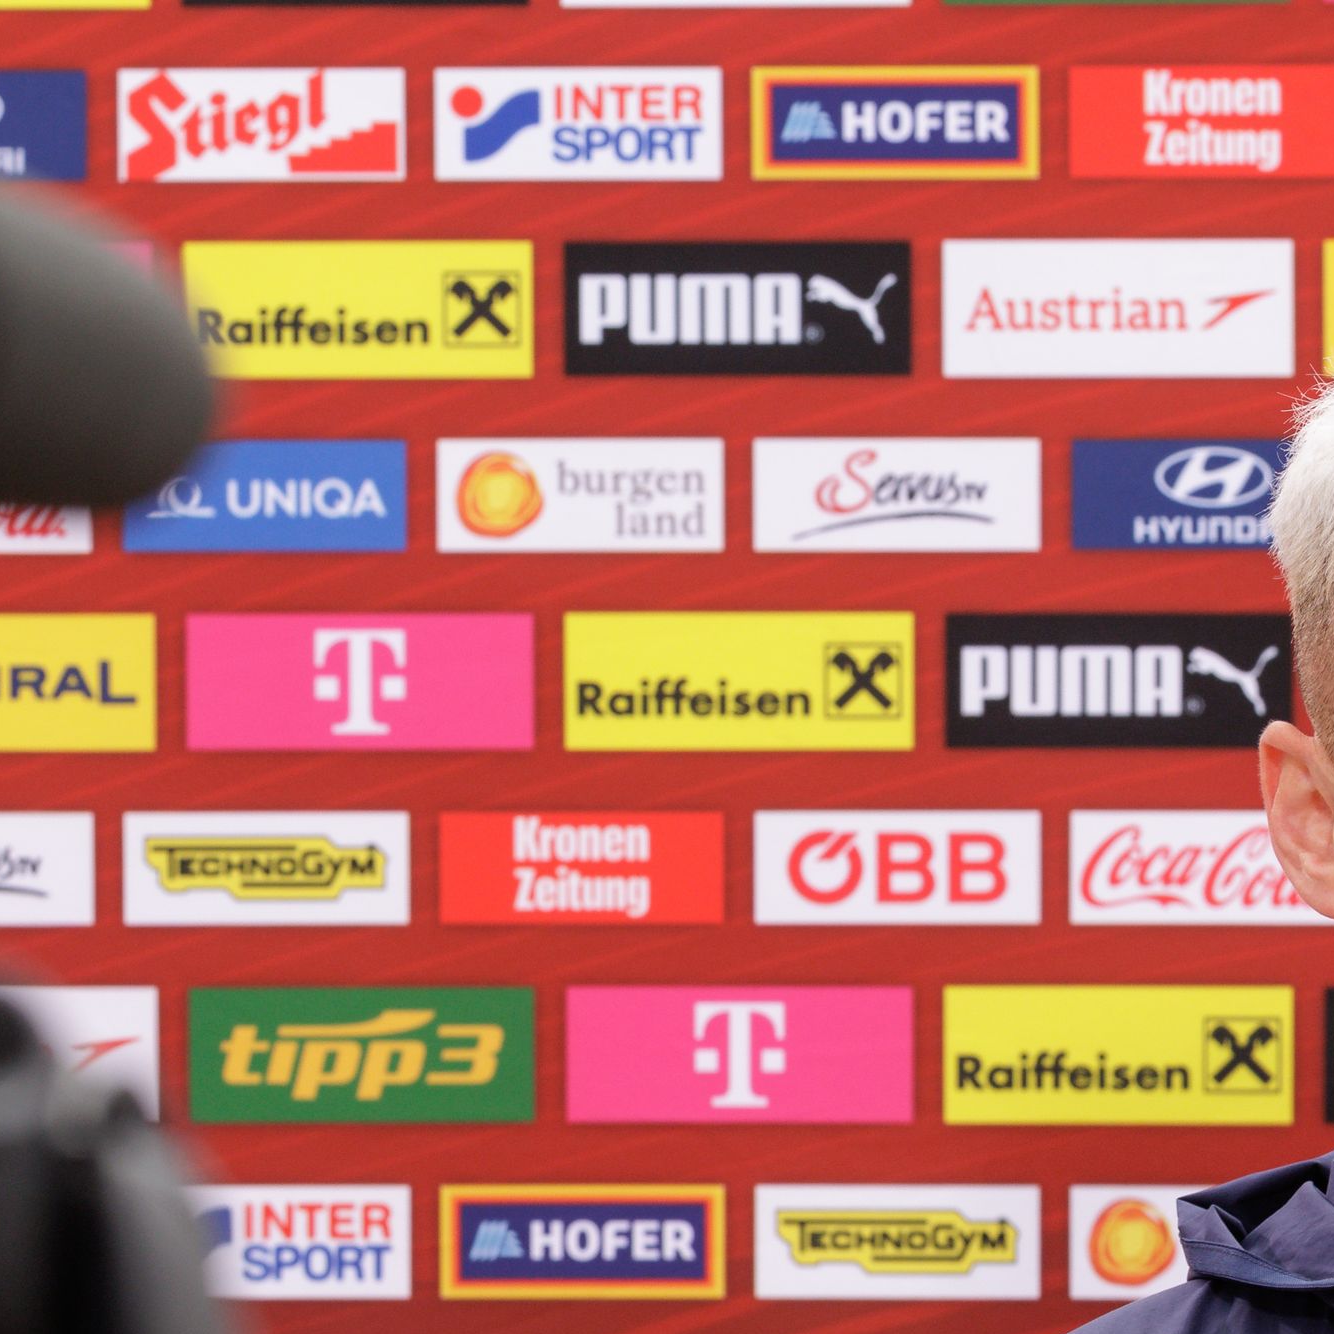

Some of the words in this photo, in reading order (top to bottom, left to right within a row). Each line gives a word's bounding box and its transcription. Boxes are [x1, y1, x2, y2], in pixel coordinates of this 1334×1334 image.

[555, 86, 701, 120] INTER
[1144, 70, 1281, 116] Kronen
[125, 69, 327, 182] Stiegl
[842, 101, 1008, 142] HOFER
[553, 126, 701, 162] SPORT
[1144, 119, 1281, 171] Zeitung
[196, 307, 429, 349] Raiffeisen
[579, 274, 802, 344] PUMA
[966, 288, 1187, 331] Austrian
[227, 478, 385, 518] UNIQA
[557, 460, 706, 501] burgen
[615, 500, 706, 538] land
[1133, 515, 1271, 544] HYUND
[314, 629, 406, 735] T
[578, 679, 810, 716] Raiffeisen
[961, 646, 1182, 716] PUMA
[513, 816, 650, 862] Kronen
[787, 831, 1007, 905] ÖBB
[514, 866, 650, 918] Zeitung
[220, 1009, 504, 1100] tipp3
[694, 1002, 785, 1108] T
[957, 1052, 1189, 1090] Raiffeisen
[245, 1204, 390, 1239] INTER
[530, 1220, 695, 1261] HOFER
[243, 1244, 390, 1281] SPORT
